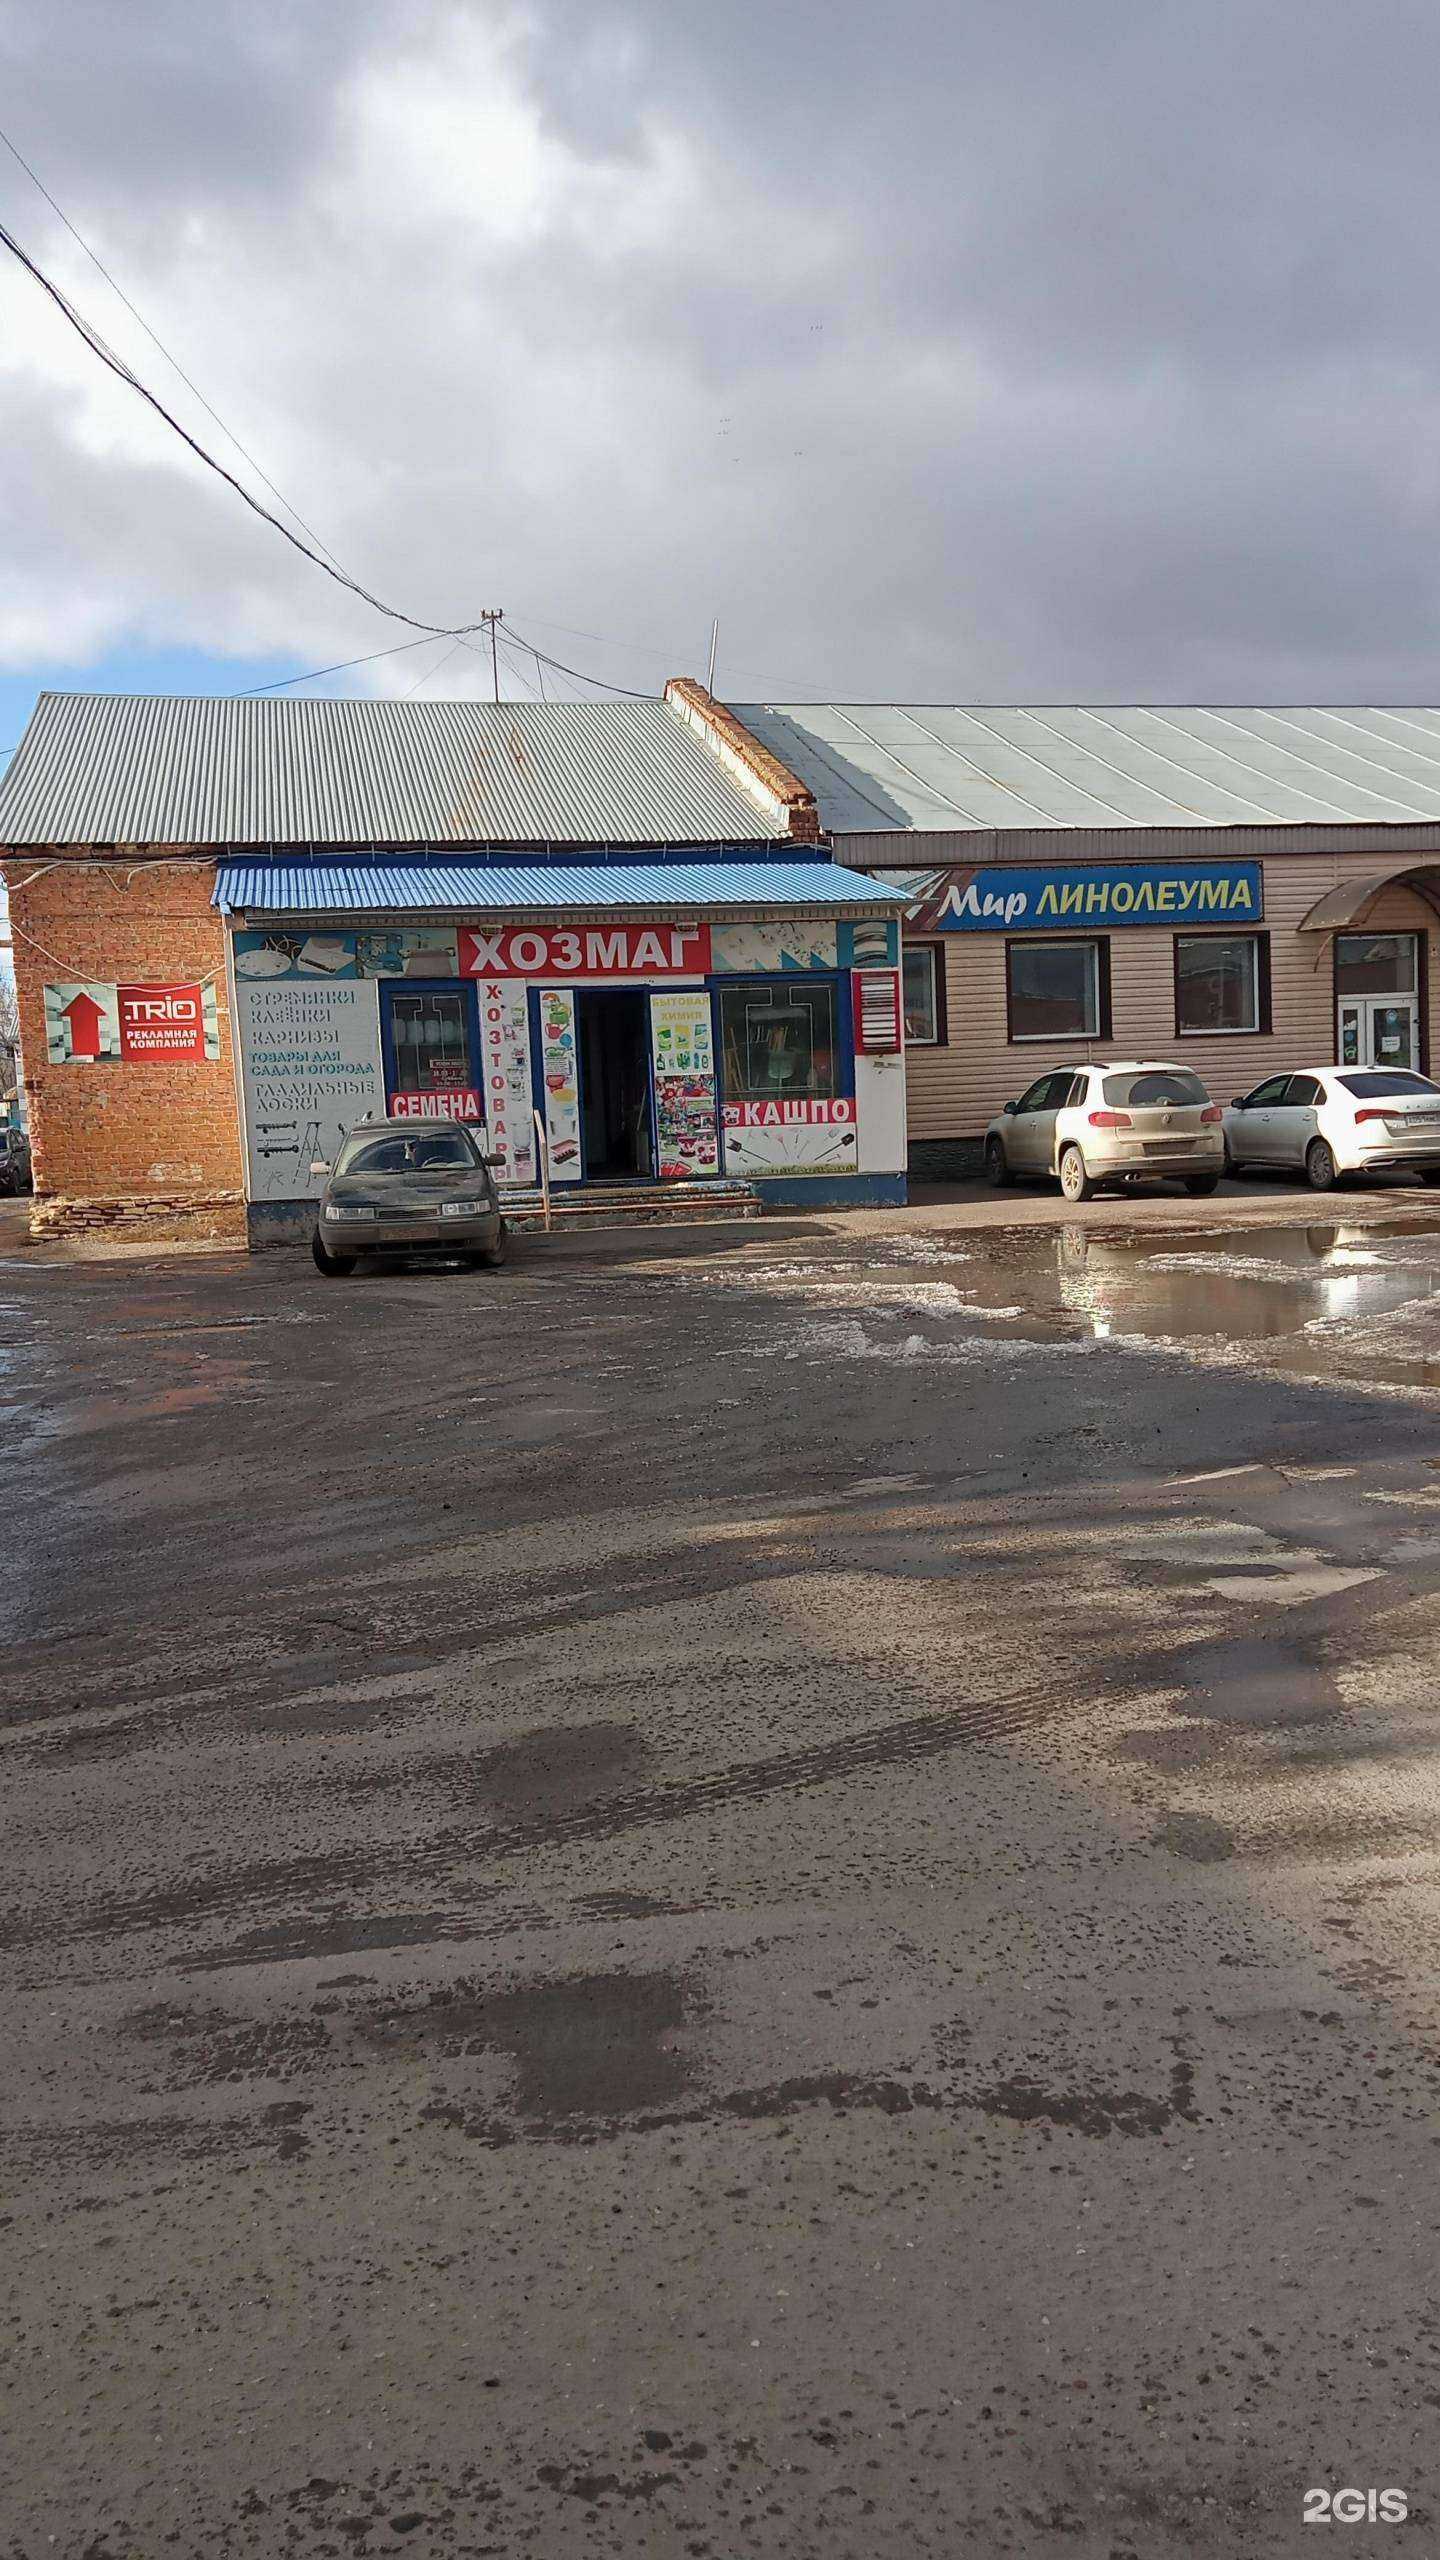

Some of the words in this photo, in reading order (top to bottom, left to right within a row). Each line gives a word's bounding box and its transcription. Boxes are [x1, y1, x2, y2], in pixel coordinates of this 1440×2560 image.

[937, 885, 1027, 923] Мир
[1036, 879, 1252, 915] ЛИНОЛЕУМА
[469, 932, 699, 971] ХОЗМАГ
[126, 1029, 197, 1040] РЕКЛАМНАЯ
[253, 1030, 340, 1045] КАРНИЗЫ
[130, 1038, 195, 1049] КОМПАНИЯ
[249, 1051, 309, 1063] ТОВАРЫ
[312, 1050, 341, 1063] ДЛЯ
[251, 1064, 291, 1077] САДА
[308, 1062, 375, 1076] ОГОРОДА
[393, 1093, 479, 1119] СЕМЕНА
[744, 1099, 850, 1126] КАШПО
